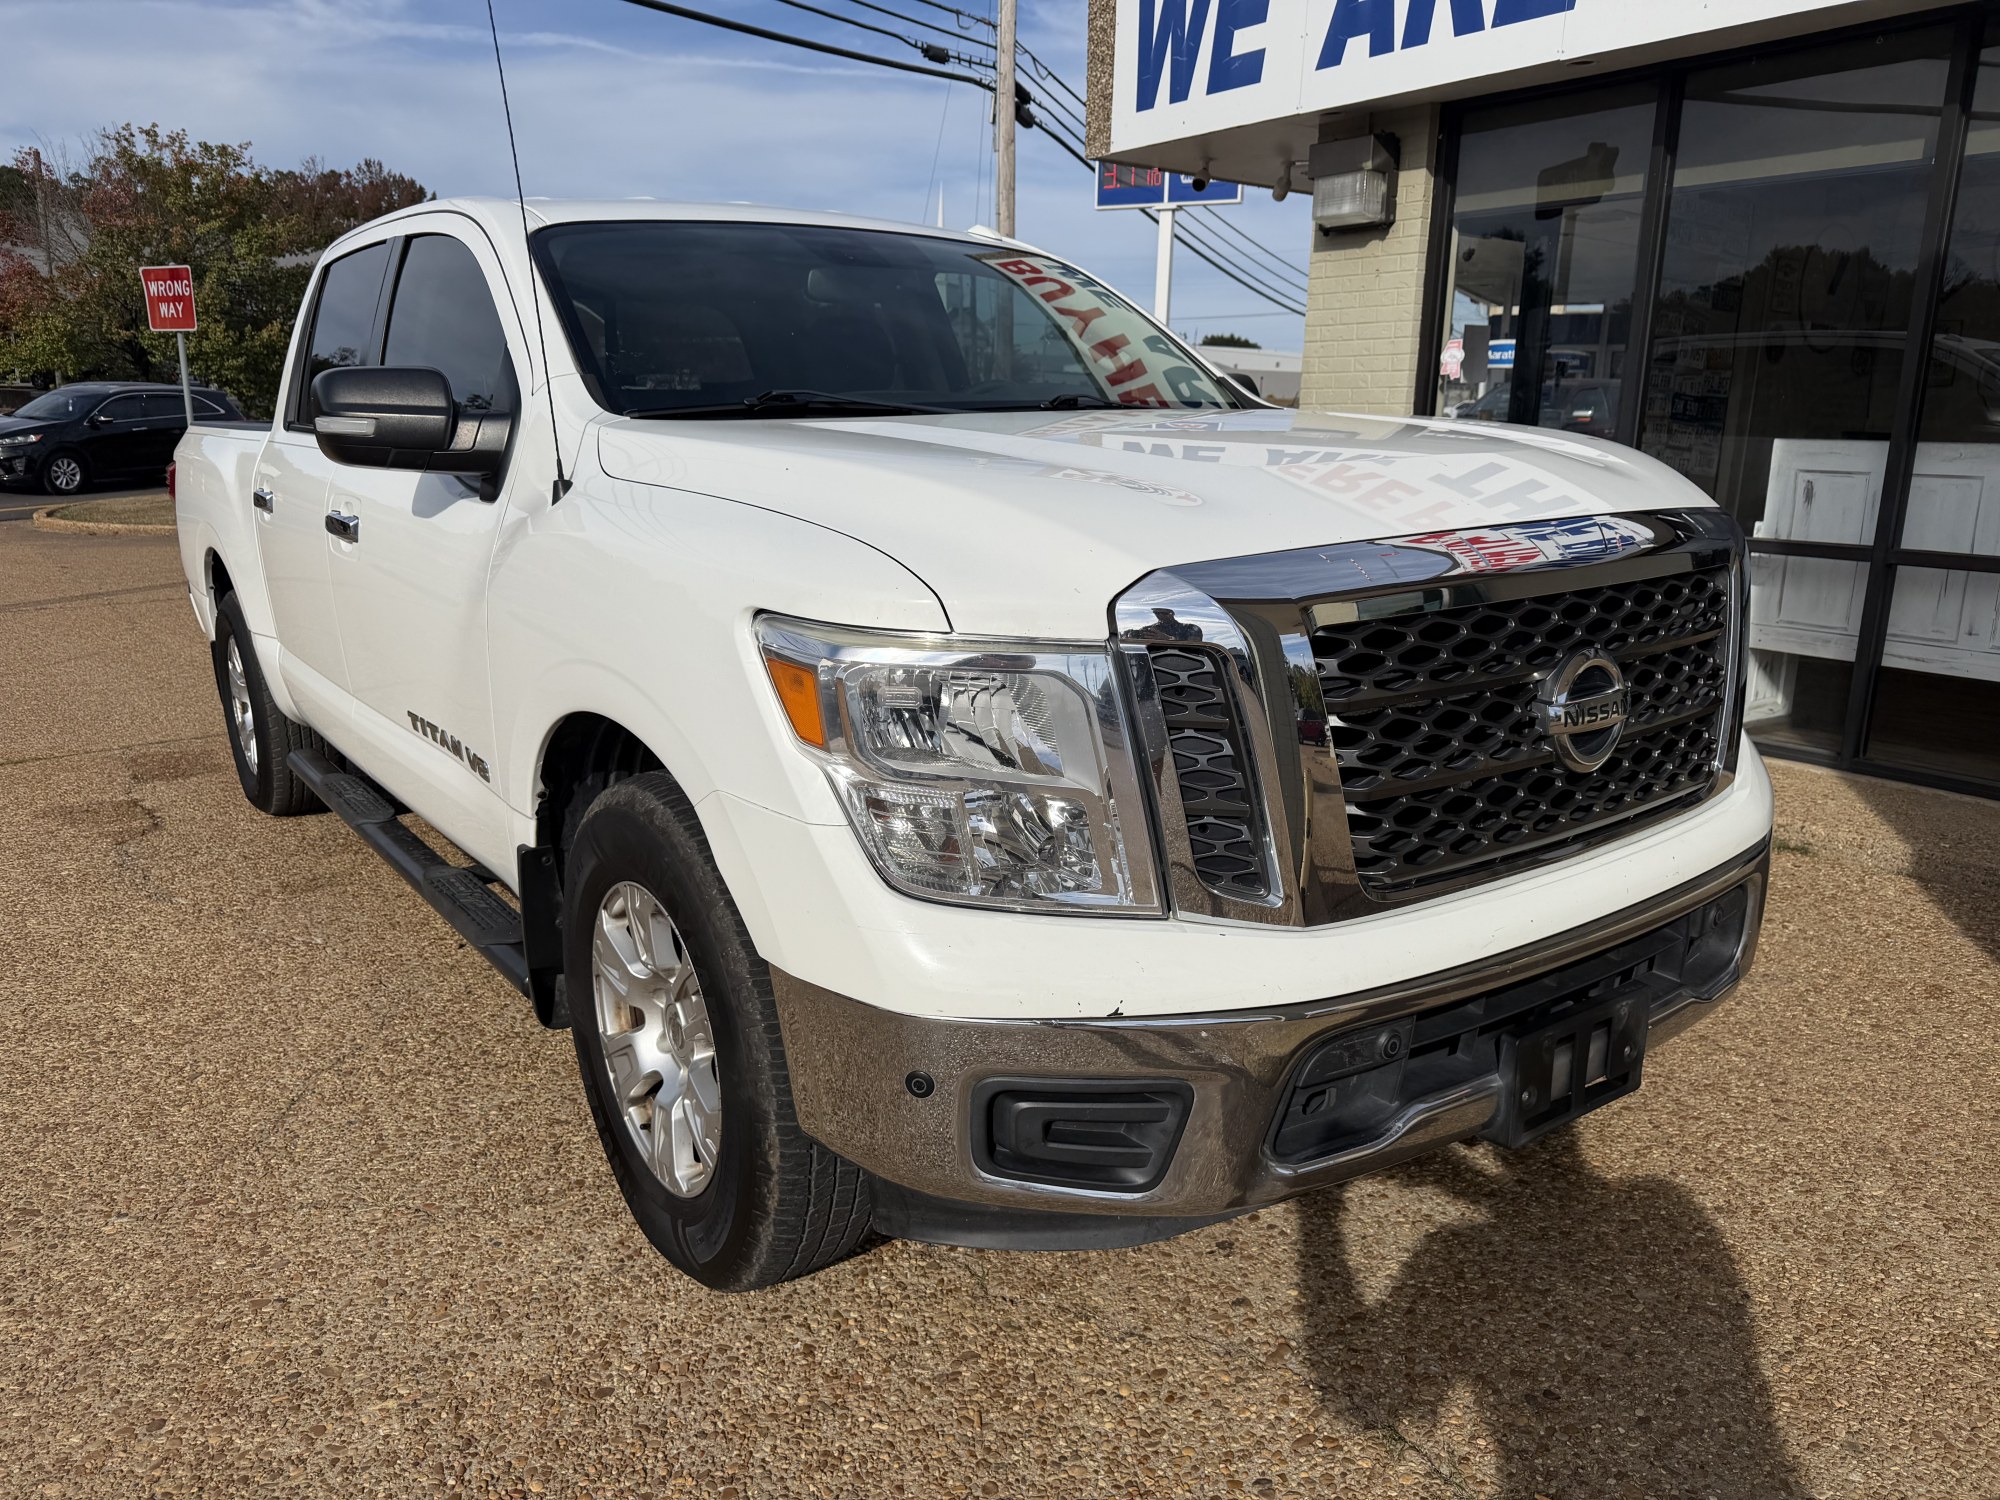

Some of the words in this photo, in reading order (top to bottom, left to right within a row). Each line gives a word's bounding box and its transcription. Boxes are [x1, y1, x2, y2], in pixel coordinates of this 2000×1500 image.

[1136, 0, 1270, 112] WE
[148, 280, 190, 297] WRONG
[159, 302, 184, 318] WAY
[1564, 699, 1629, 727] NISSAN
[407, 710, 464, 762] TITAN
[465, 745, 490, 783] V8
